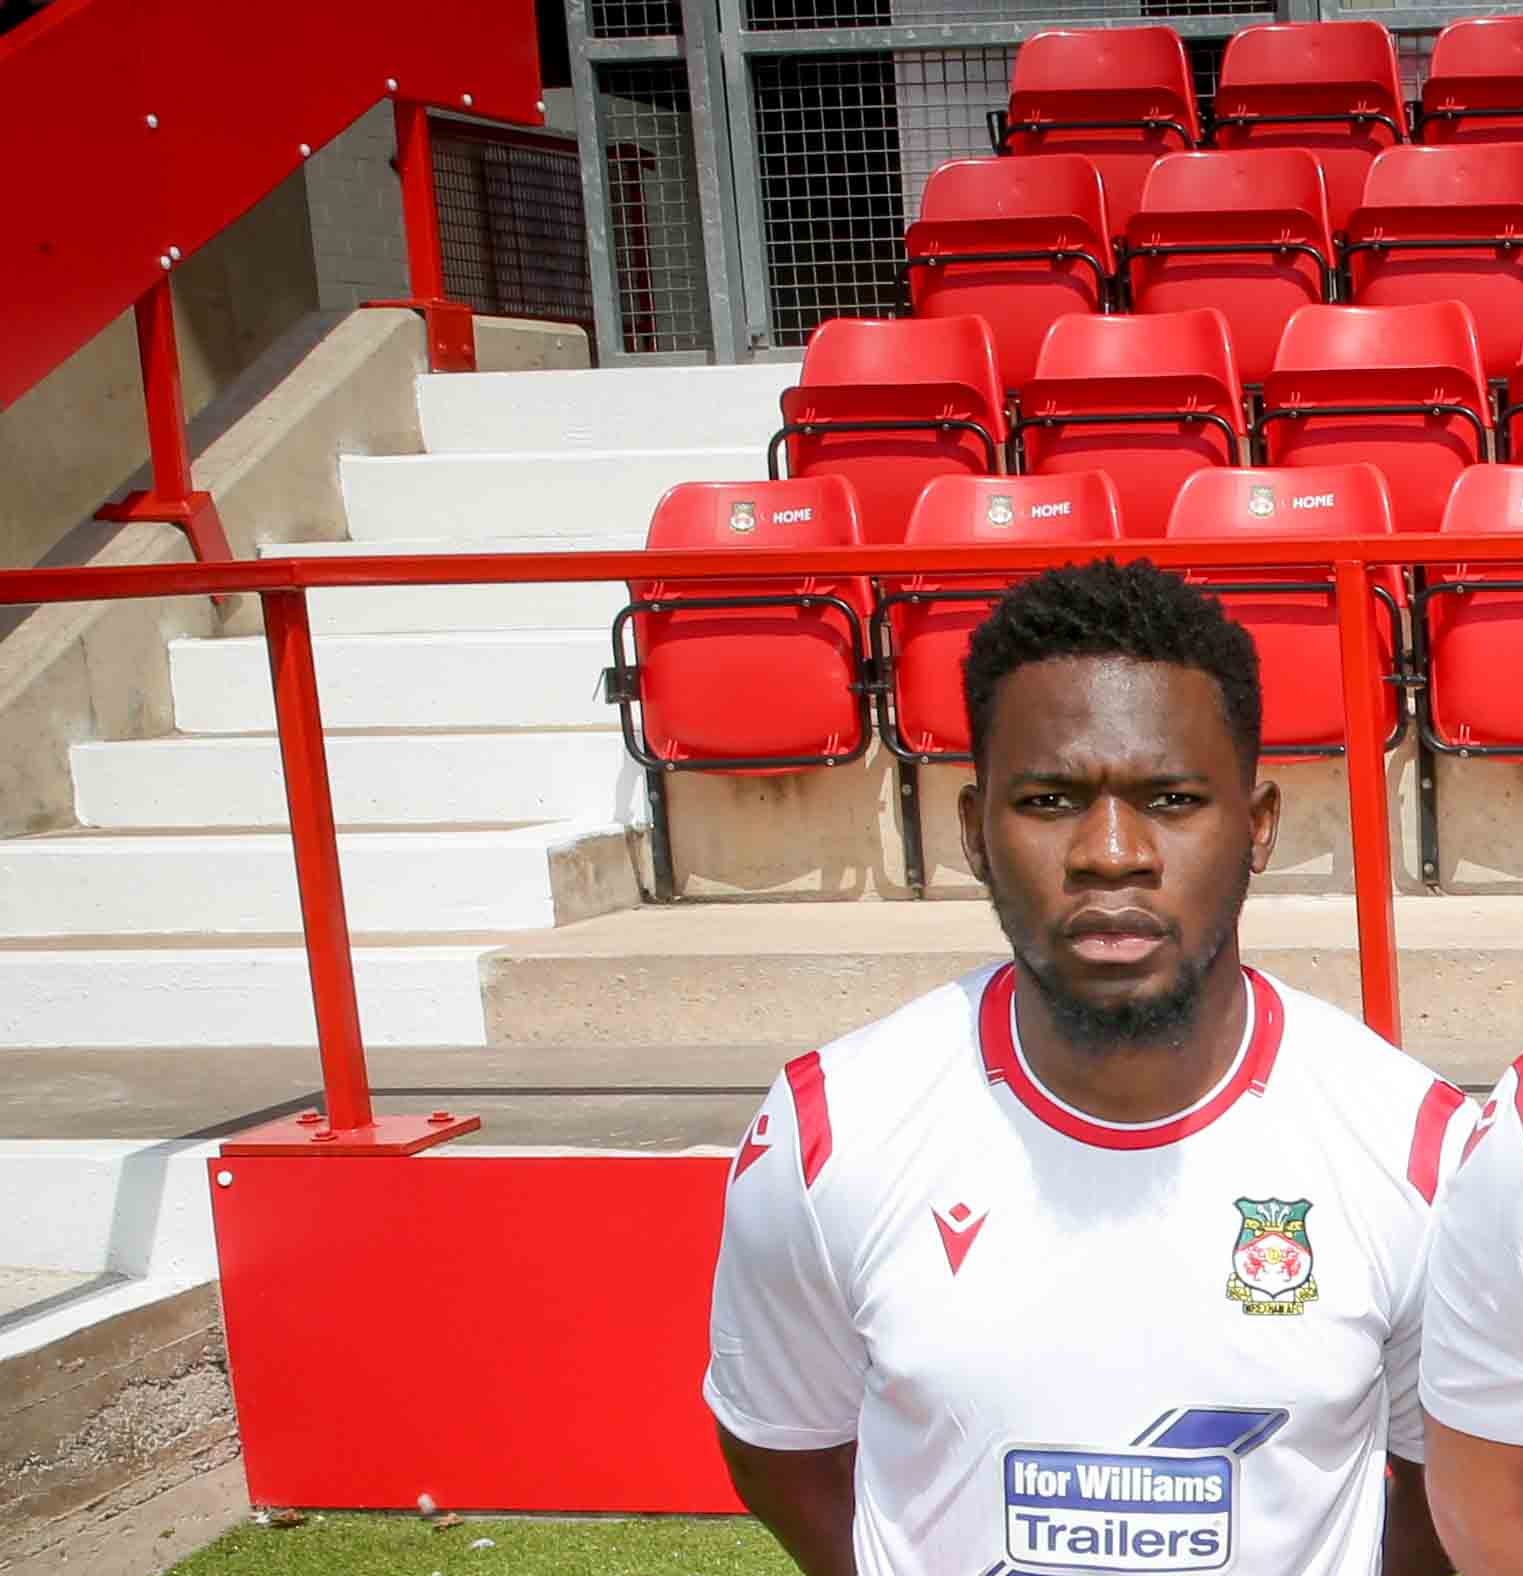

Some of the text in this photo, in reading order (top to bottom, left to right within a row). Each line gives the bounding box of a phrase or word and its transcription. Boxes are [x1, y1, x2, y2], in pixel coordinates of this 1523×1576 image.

[1031, 500, 1073, 519] HOME
[1292, 493, 1336, 510] HOME
[772, 507, 813, 525] HOME
[1013, 1460, 1223, 1504] Ifor Williams
[1015, 1512, 1220, 1558] Trailers
